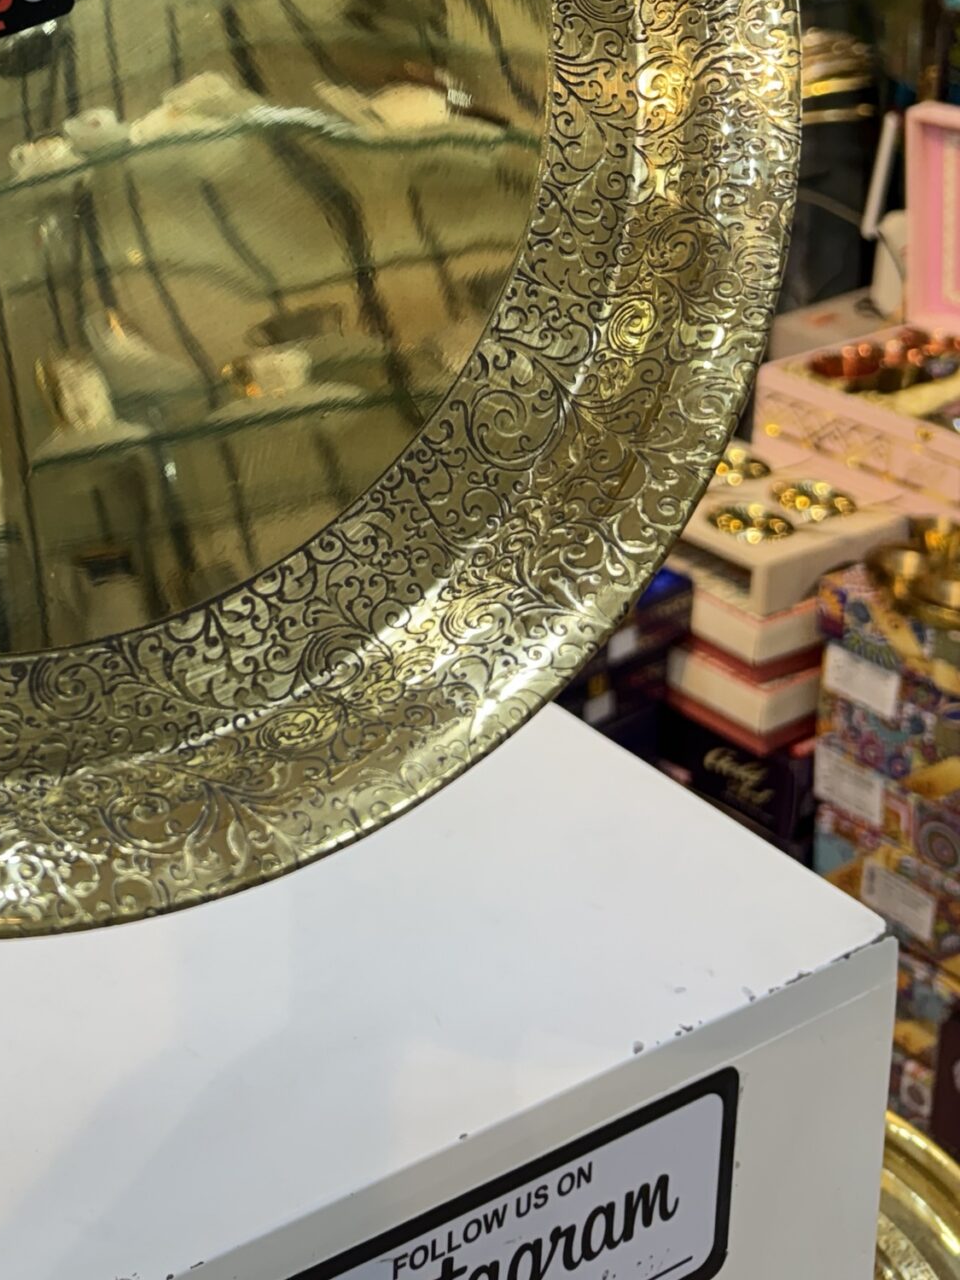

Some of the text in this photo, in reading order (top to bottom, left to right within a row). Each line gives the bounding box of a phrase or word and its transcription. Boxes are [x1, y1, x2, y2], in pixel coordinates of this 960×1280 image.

[393, 1161, 593, 1280] FOLLOW US ON
